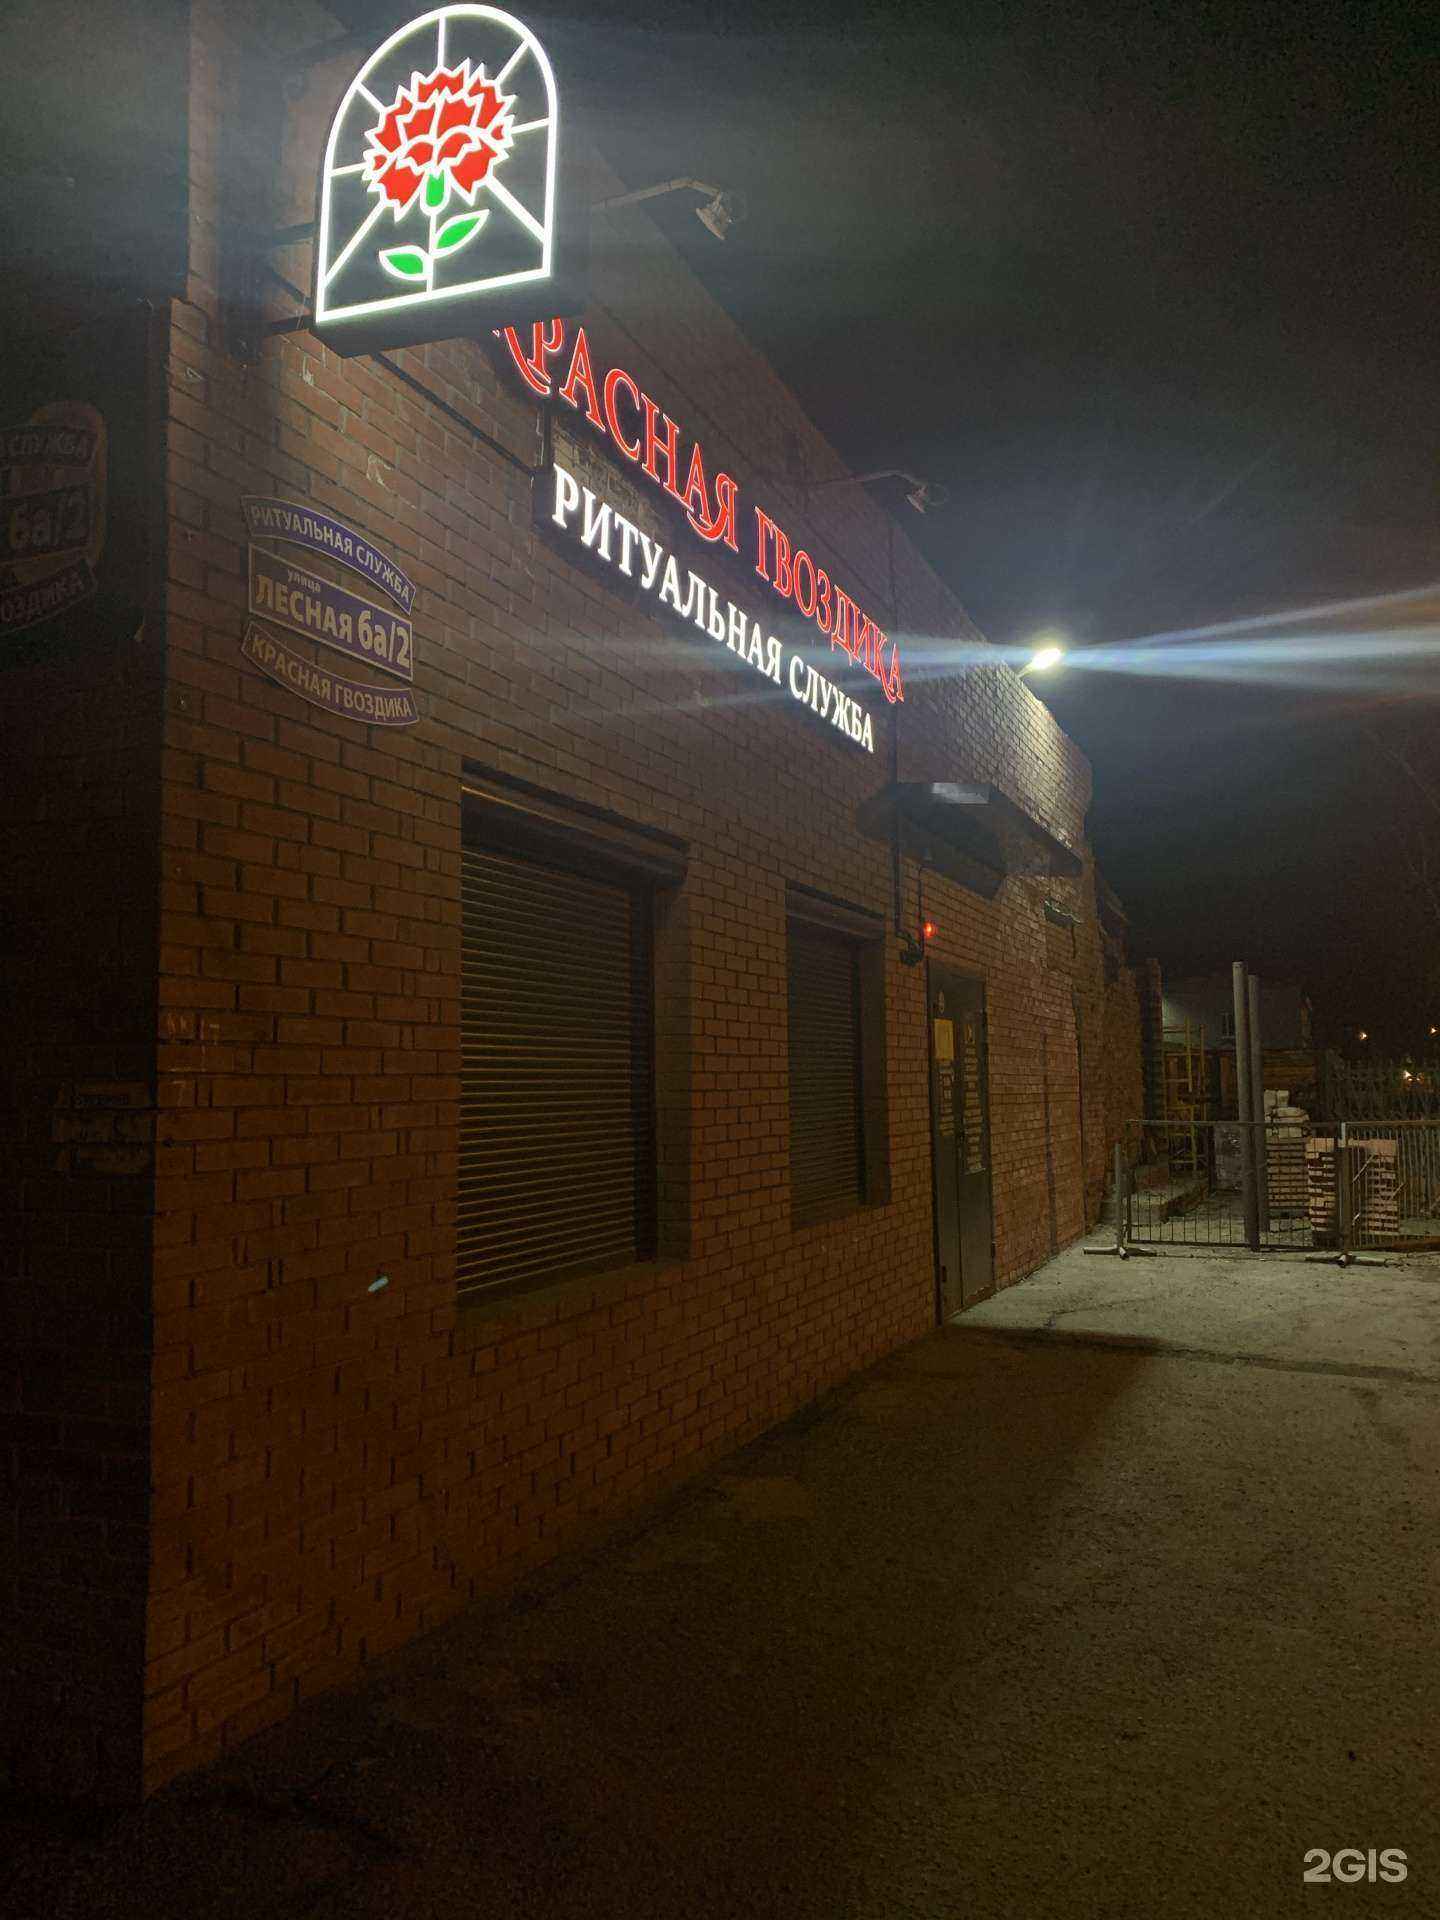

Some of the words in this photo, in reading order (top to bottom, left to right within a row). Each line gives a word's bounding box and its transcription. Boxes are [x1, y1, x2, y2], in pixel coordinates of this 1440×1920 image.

[250, 505, 353, 555] РИТУАЛЬНАЯ
[356, 545, 410, 604] СЛУЖБА
[287, 568, 321, 593] улица
[255, 574, 352, 643] ЛЕСНАЯ
[357, 609, 411, 669] 6а/2
[551, 462, 783, 685] РИТУАЛЬНАЯ
[788, 655, 875, 753] СЛУЖБА
[754, 505, 905, 704] ГВОЗДИКА
[252, 632, 331, 701] КРАСНАЯ
[335, 683, 412, 720] ГВОЗДИКА
